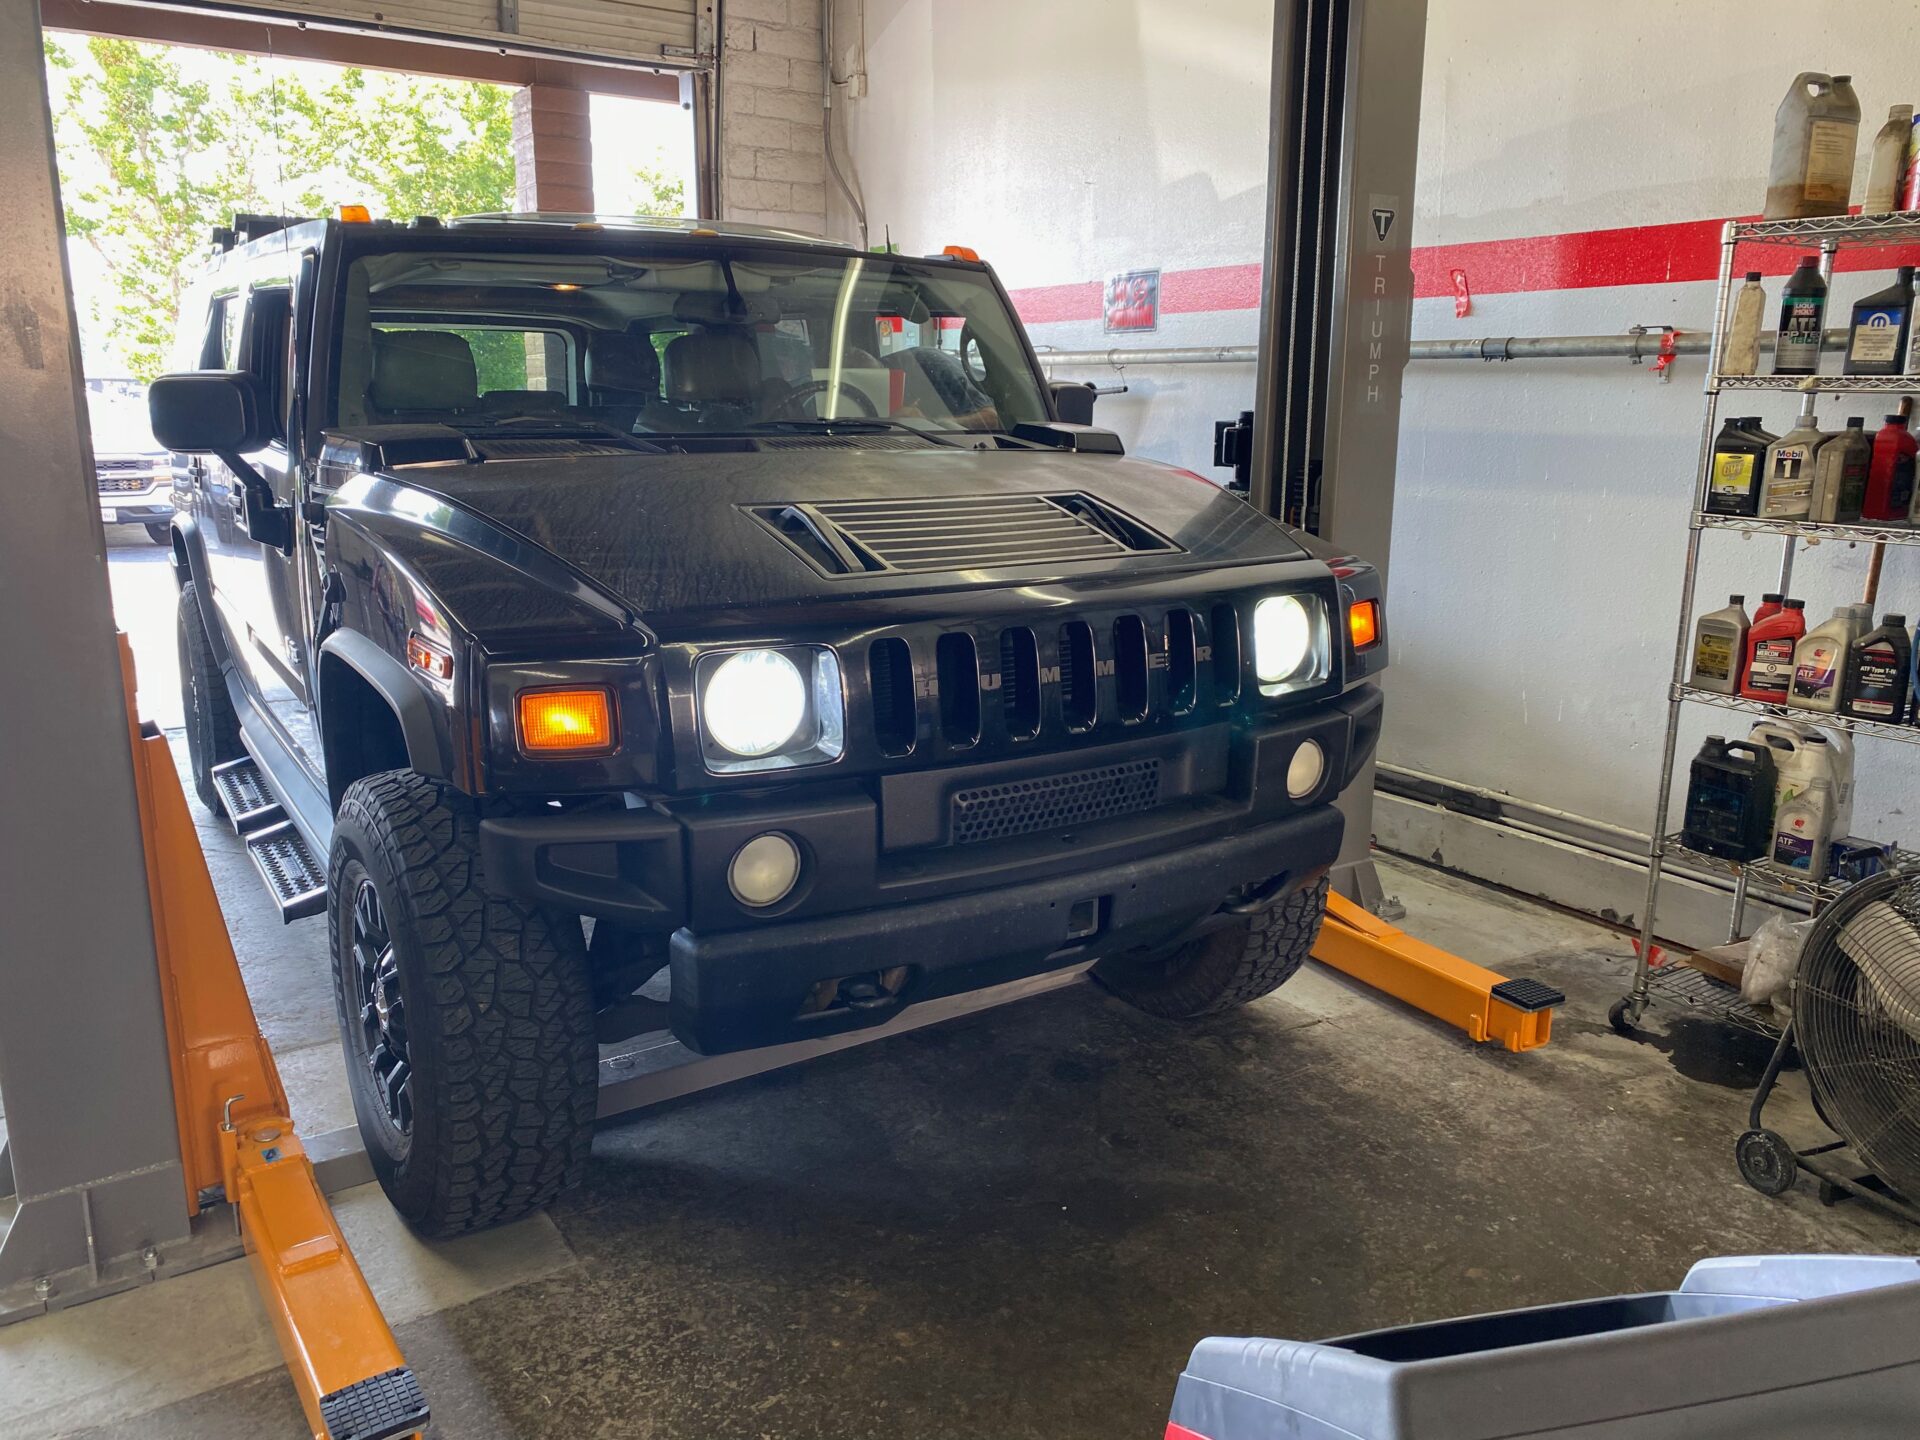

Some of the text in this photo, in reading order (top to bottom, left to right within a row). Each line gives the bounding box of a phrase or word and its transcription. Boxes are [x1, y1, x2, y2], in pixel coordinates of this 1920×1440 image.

[1367, 254, 1387, 402] TRIUMPH
[1787, 317, 1817, 331] ATF
[1776, 449, 1804, 458] Mobil
[1782, 459, 1793, 478] 1
[915, 645, 1213, 698] HUMMER
[1797, 669, 1815, 678] ATF
[1871, 666, 1885, 674] Type
[1777, 836, 1794, 846] ATF
